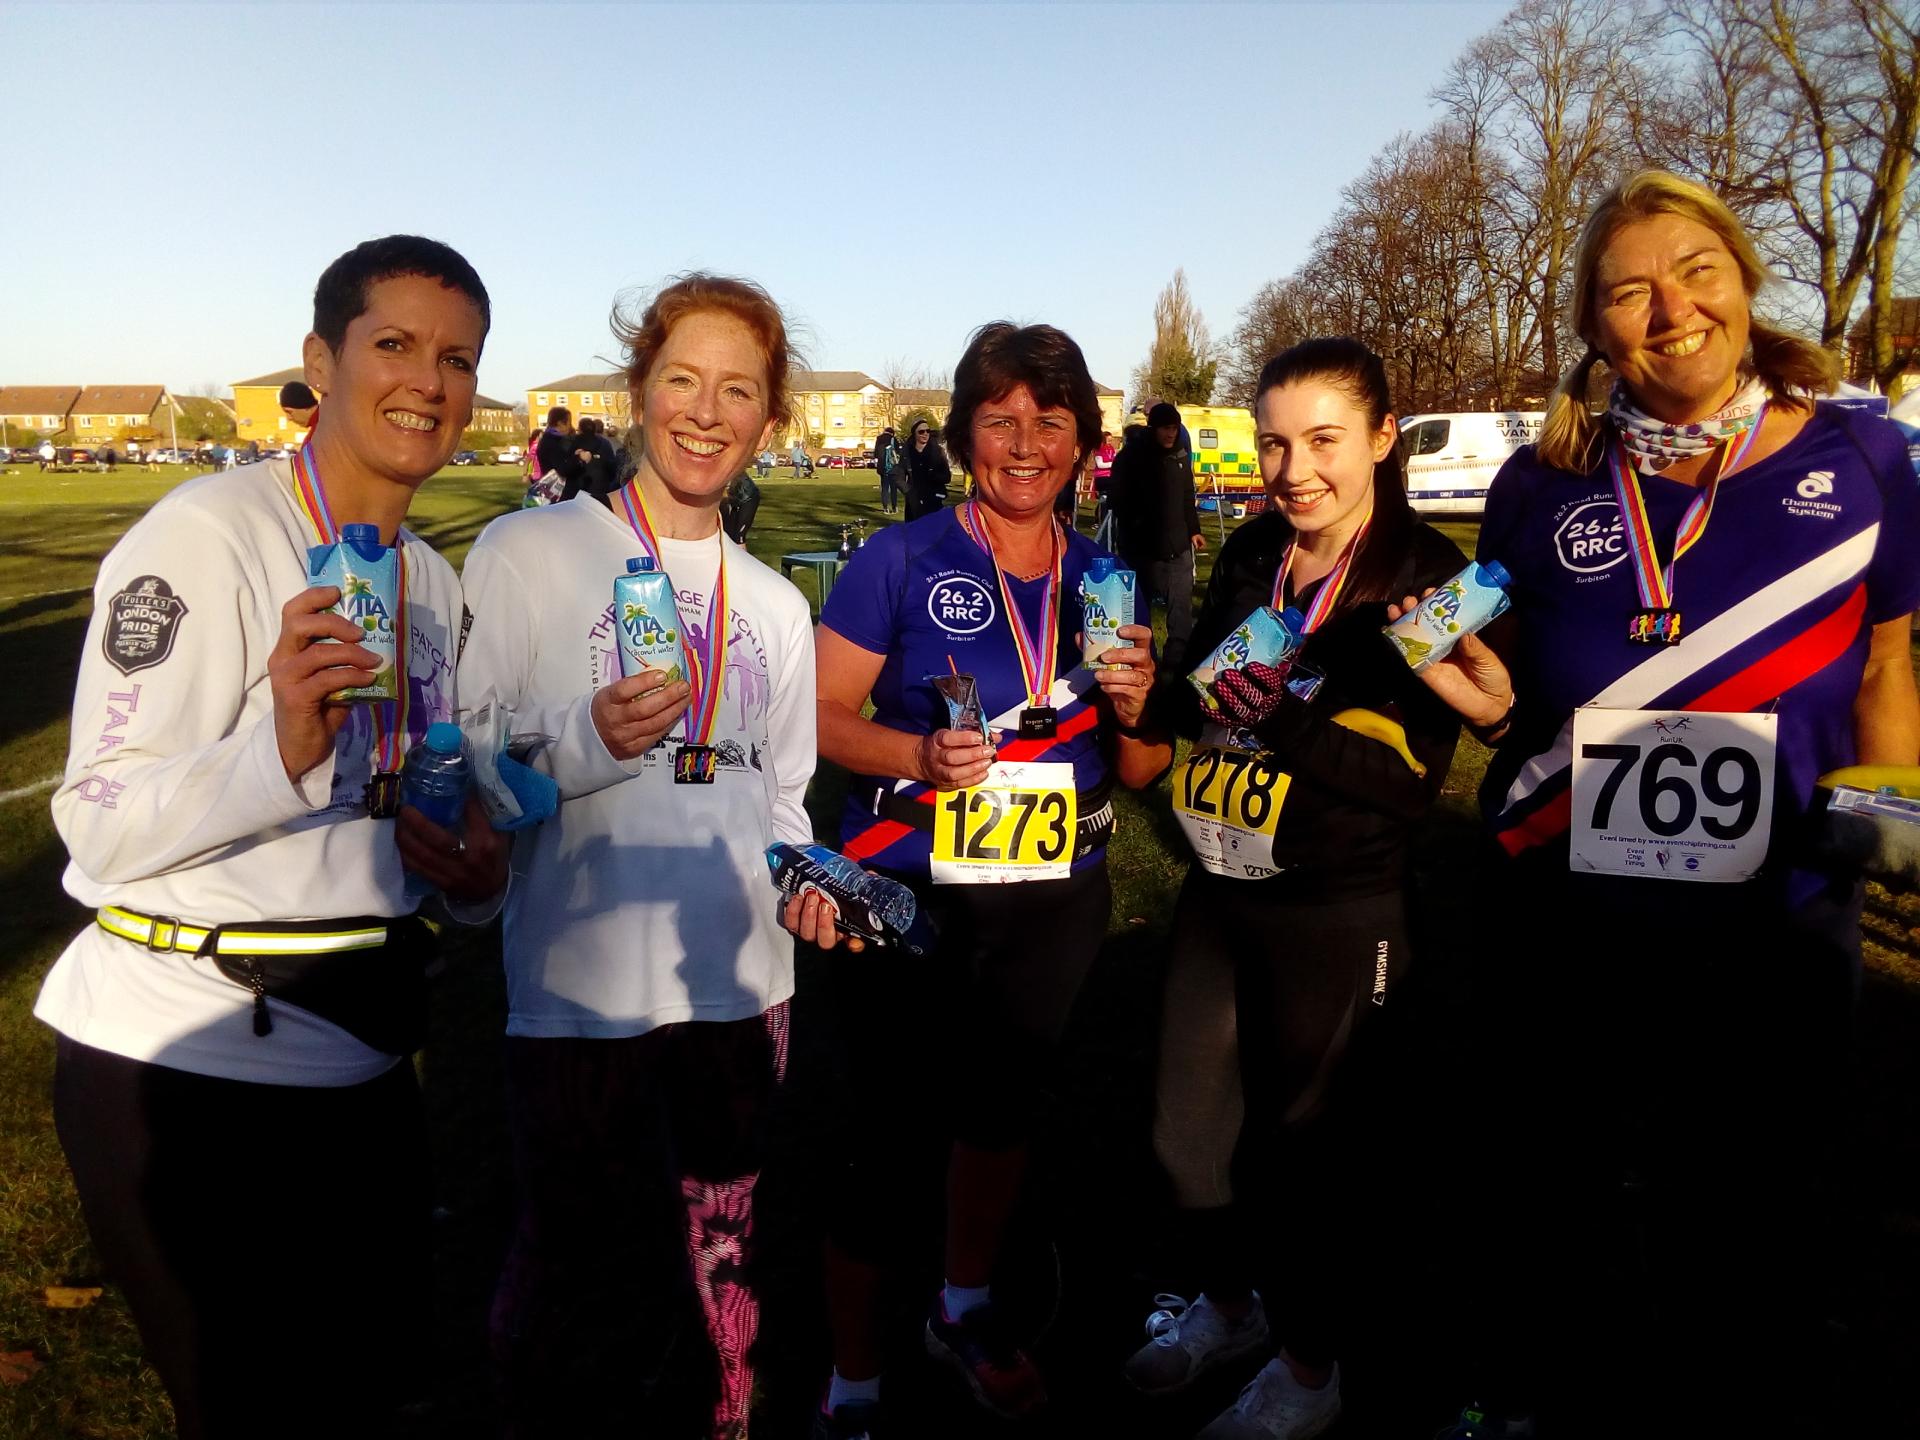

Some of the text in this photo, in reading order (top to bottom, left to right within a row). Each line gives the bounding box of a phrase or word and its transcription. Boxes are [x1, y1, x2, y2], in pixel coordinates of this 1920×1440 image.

[1496, 419, 1512, 428] ST
[1502, 429, 1530, 438] VAN
[1782, 498, 1842, 512] Champion
[1787, 506, 1834, 519] System
[1567, 515, 1624, 539] 26.2
[1572, 534, 1622, 559] RRC
[1575, 573, 1611, 583] Surbiton
[337, 593, 387, 617] VITA
[939, 588, 984, 607] 26.2
[1434, 588, 1462, 621] VITA
[116, 608, 171, 626] LONDON
[942, 606, 982, 621] RRC
[1086, 616, 1119, 629] COCO
[1428, 599, 1460, 634] COCO
[120, 621, 160, 634] PRIDE
[621, 615, 666, 636] VITA
[631, 628, 676, 647] COCO
[946, 633, 976, 642] Surbiton
[411, 625, 453, 677] PATCH
[630, 644, 675, 657] coconut water
[1222, 644, 1245, 671] COC
[589, 645, 600, 692] ESTABL
[1184, 747, 1280, 829] 1278
[1582, 743, 1762, 841] 769
[946, 789, 1068, 862] 1273
[1637, 837, 1647, 845] by
[1625, 860, 1645, 868] Timing
[1627, 853, 1642, 861] Chip
[1373, 940, 1388, 994] GYMSHARK
